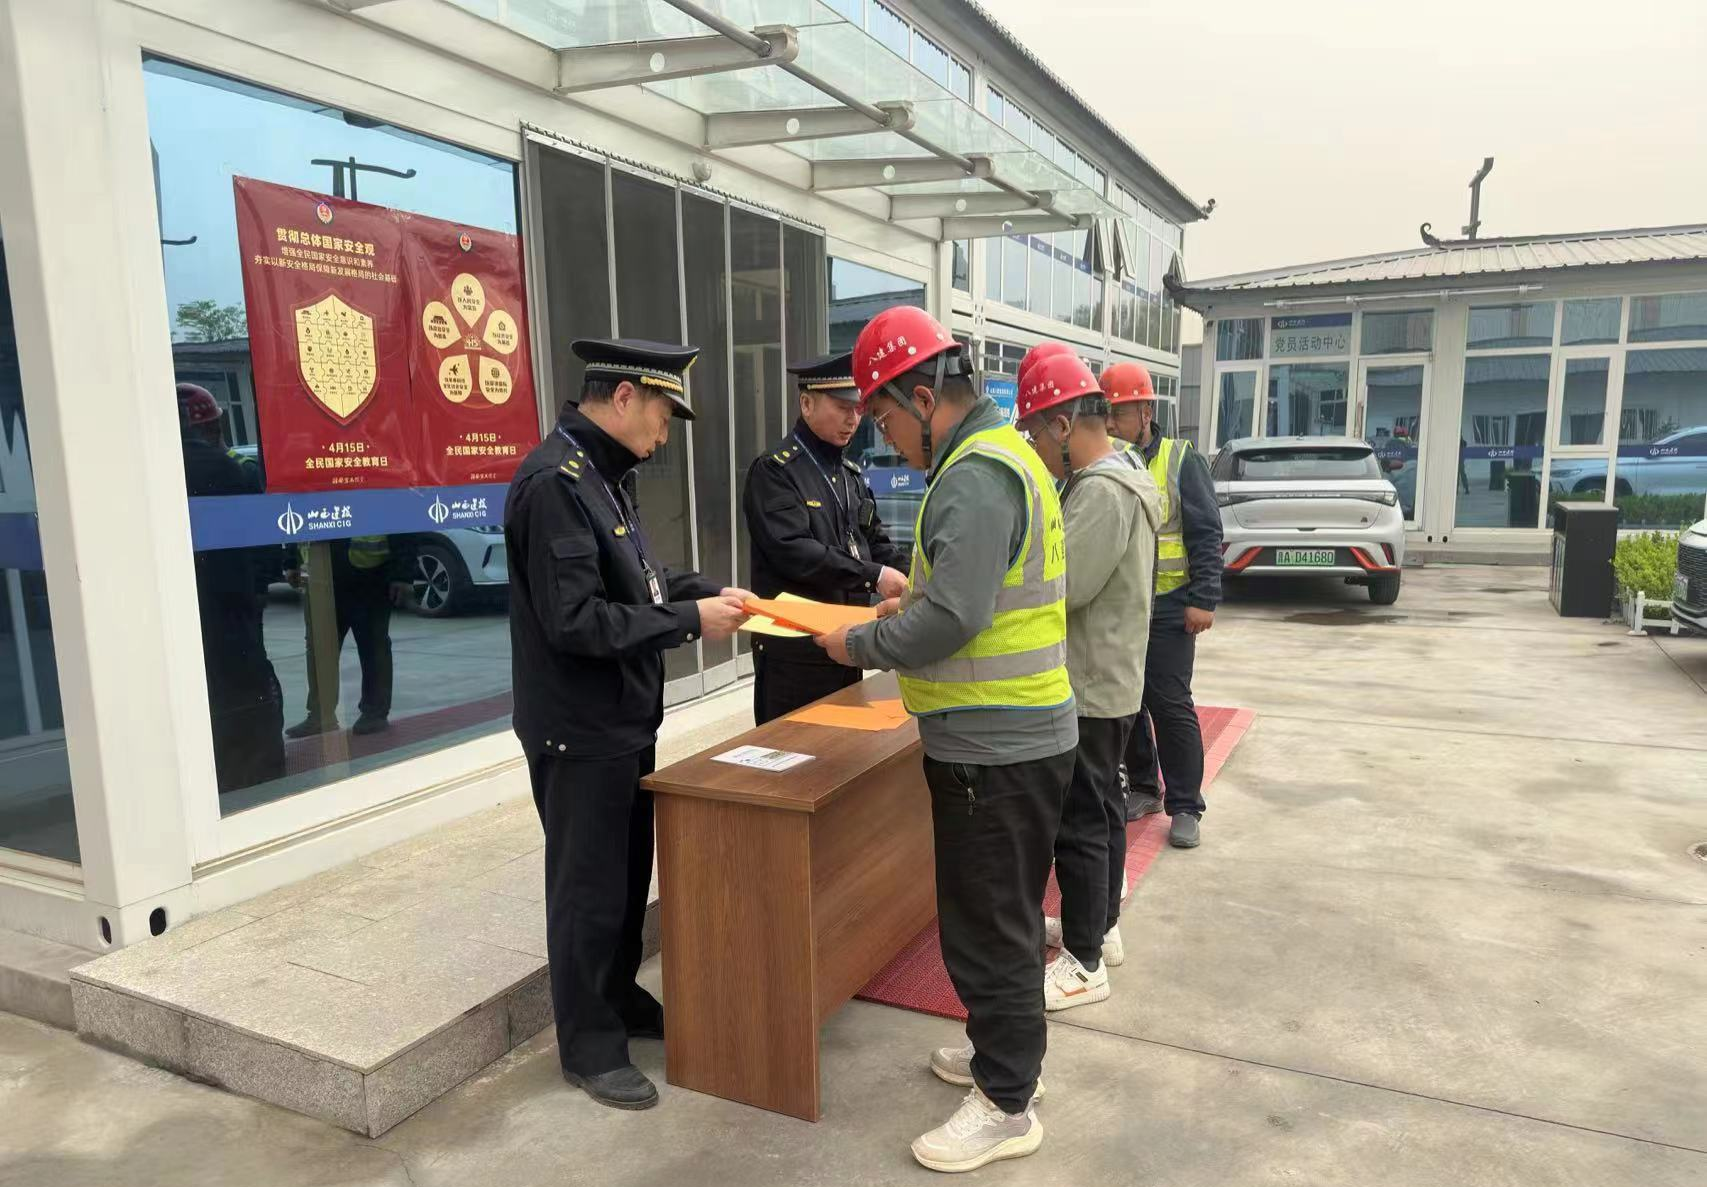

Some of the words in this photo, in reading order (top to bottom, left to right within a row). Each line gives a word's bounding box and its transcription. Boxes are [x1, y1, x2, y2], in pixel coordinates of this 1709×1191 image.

[276, 227, 375, 256] 贯彻总体国家安全观
[281, 246, 374, 268] 增强全民国家安全意识和素养
[868, 335, 907, 366] 八建集团
[1275, 334, 1346, 352] 党员活动中心
[446, 445, 517, 456] 全民国家安全教育日
[305, 456, 388, 469] 全民国家安全教育日
[452, 511, 474, 519] SHANXI
[474, 510, 487, 518] CIG
[308, 520, 336, 530] SHANXI
[337, 520, 352, 528] CIG
